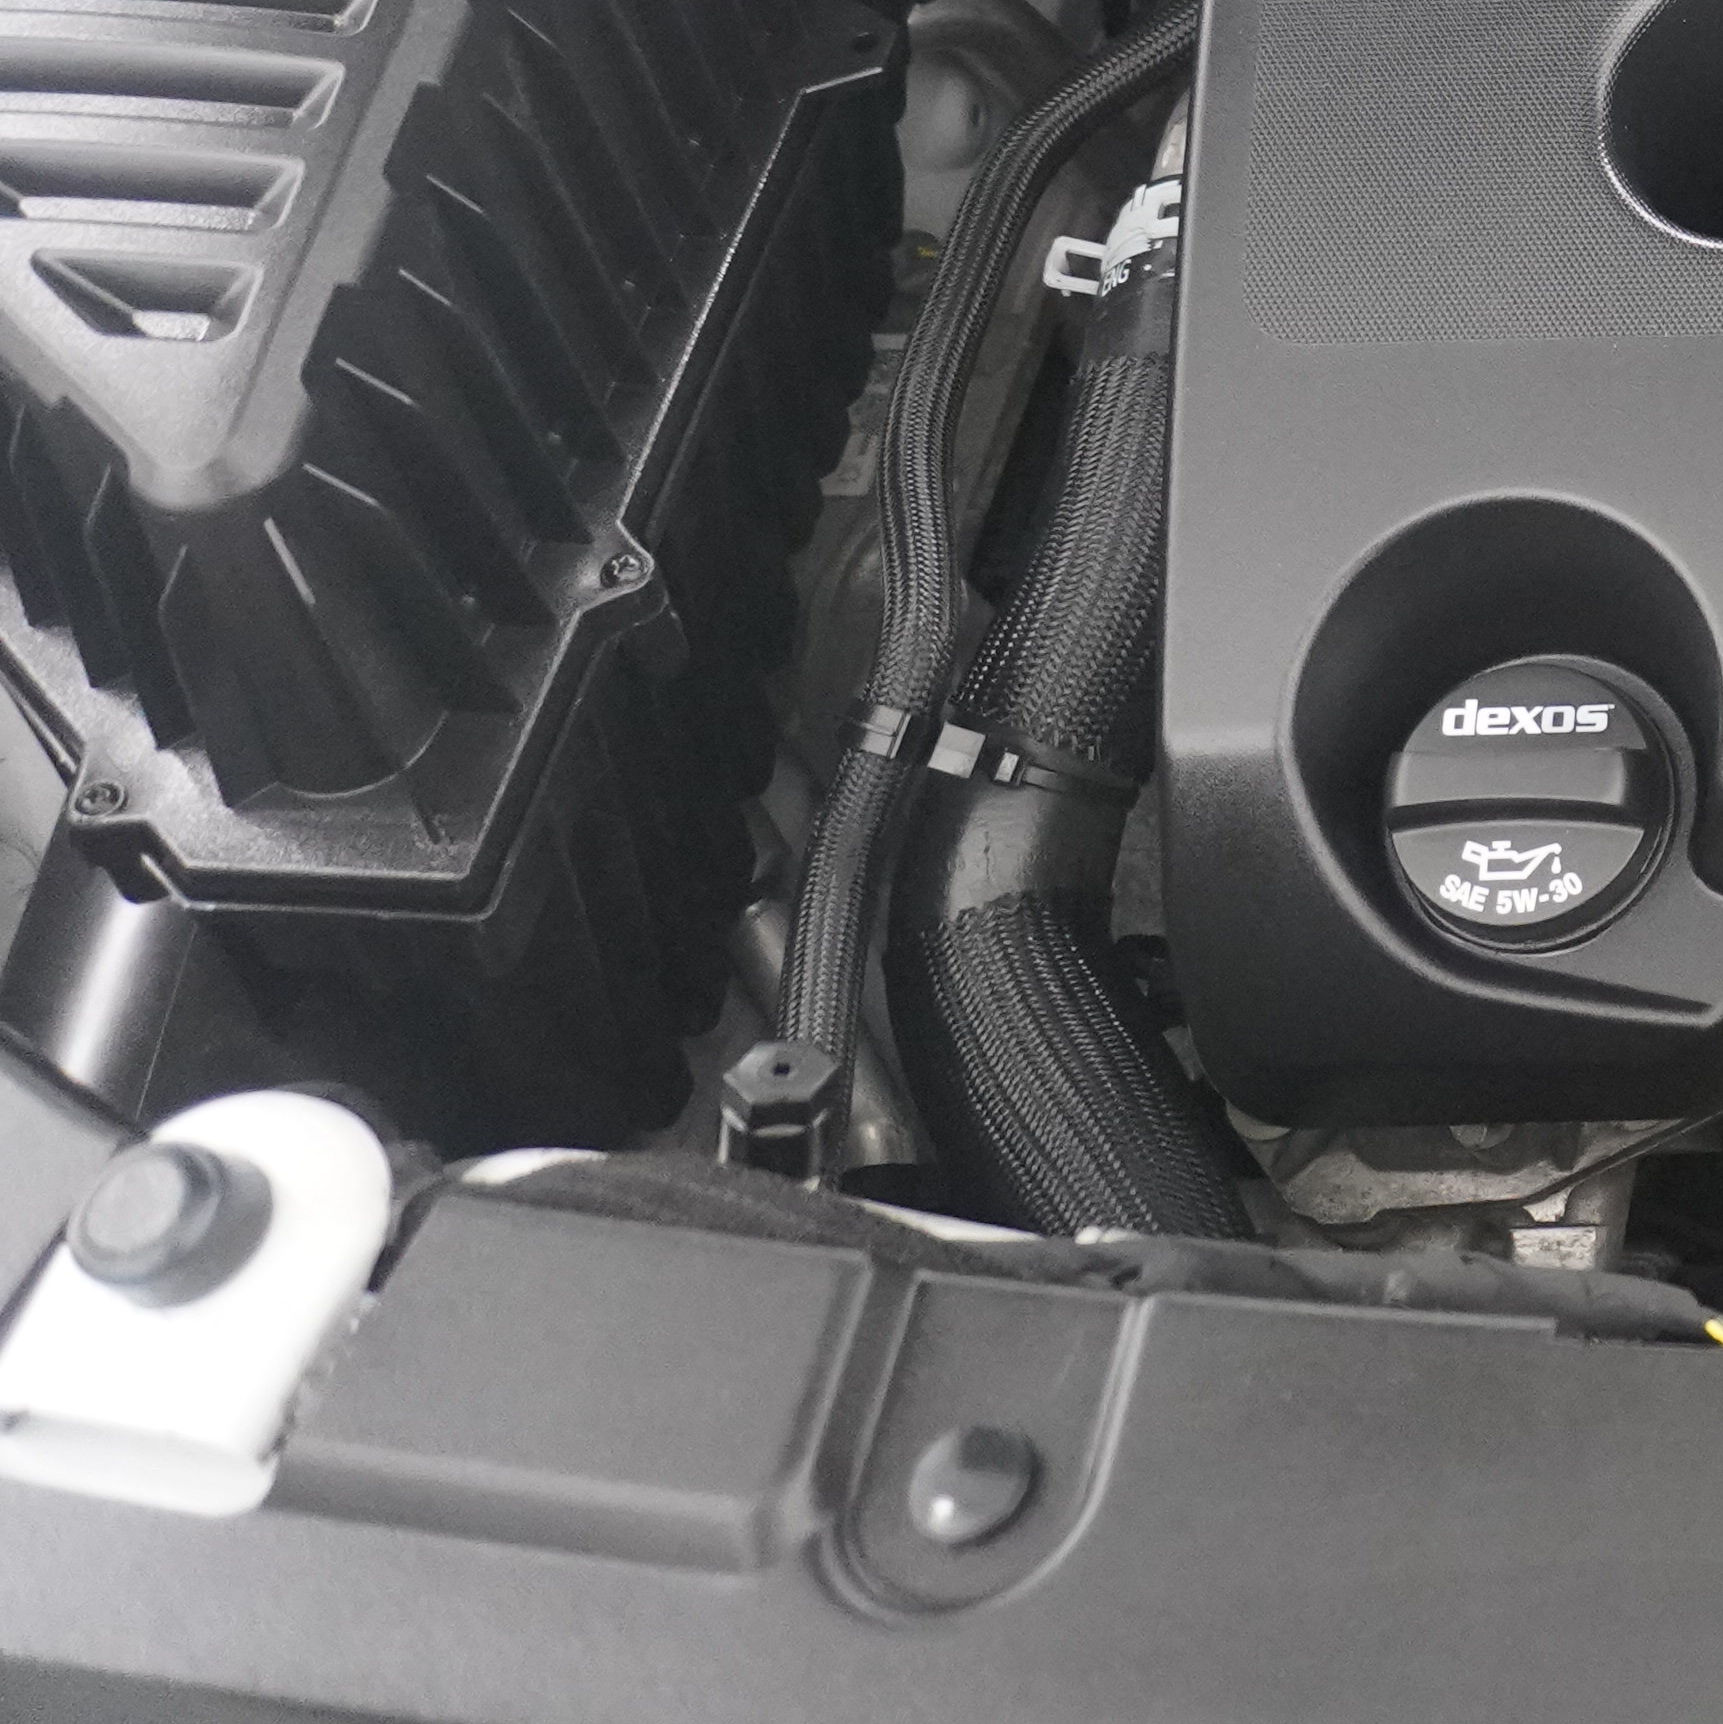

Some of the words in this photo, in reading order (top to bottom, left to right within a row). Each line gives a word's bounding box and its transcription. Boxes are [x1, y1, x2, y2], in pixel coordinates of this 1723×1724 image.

[1102, 258, 1132, 297] ENG
[1441, 698, 1612, 737] dexos
[1439, 873, 1490, 913] SAE
[1495, 871, 1584, 915] 5W-30
